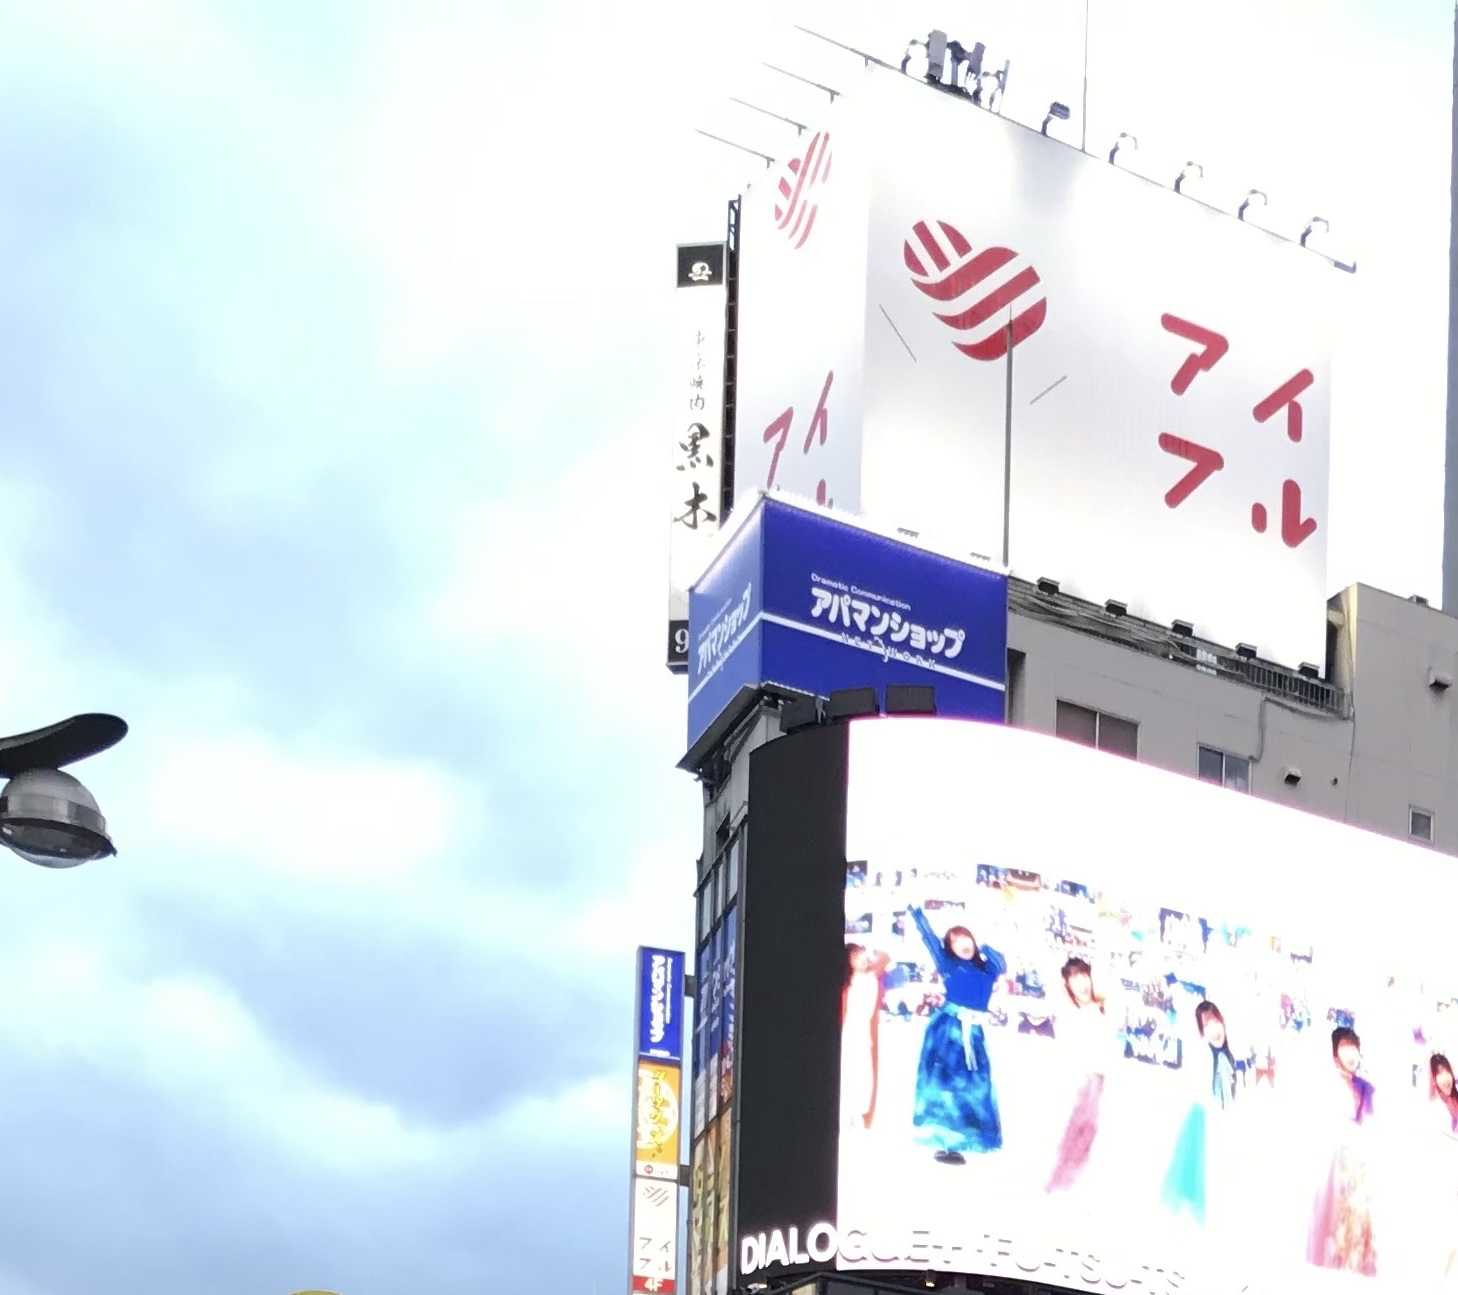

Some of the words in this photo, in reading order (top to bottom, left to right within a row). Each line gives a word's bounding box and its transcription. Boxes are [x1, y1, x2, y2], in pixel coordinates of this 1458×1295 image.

[811, 572, 849, 592] Dramatic
[850, 585, 912, 611] Communication
[810, 586, 966, 659] アパマンショップ
[643, 1276, 664, 1292] 4F
